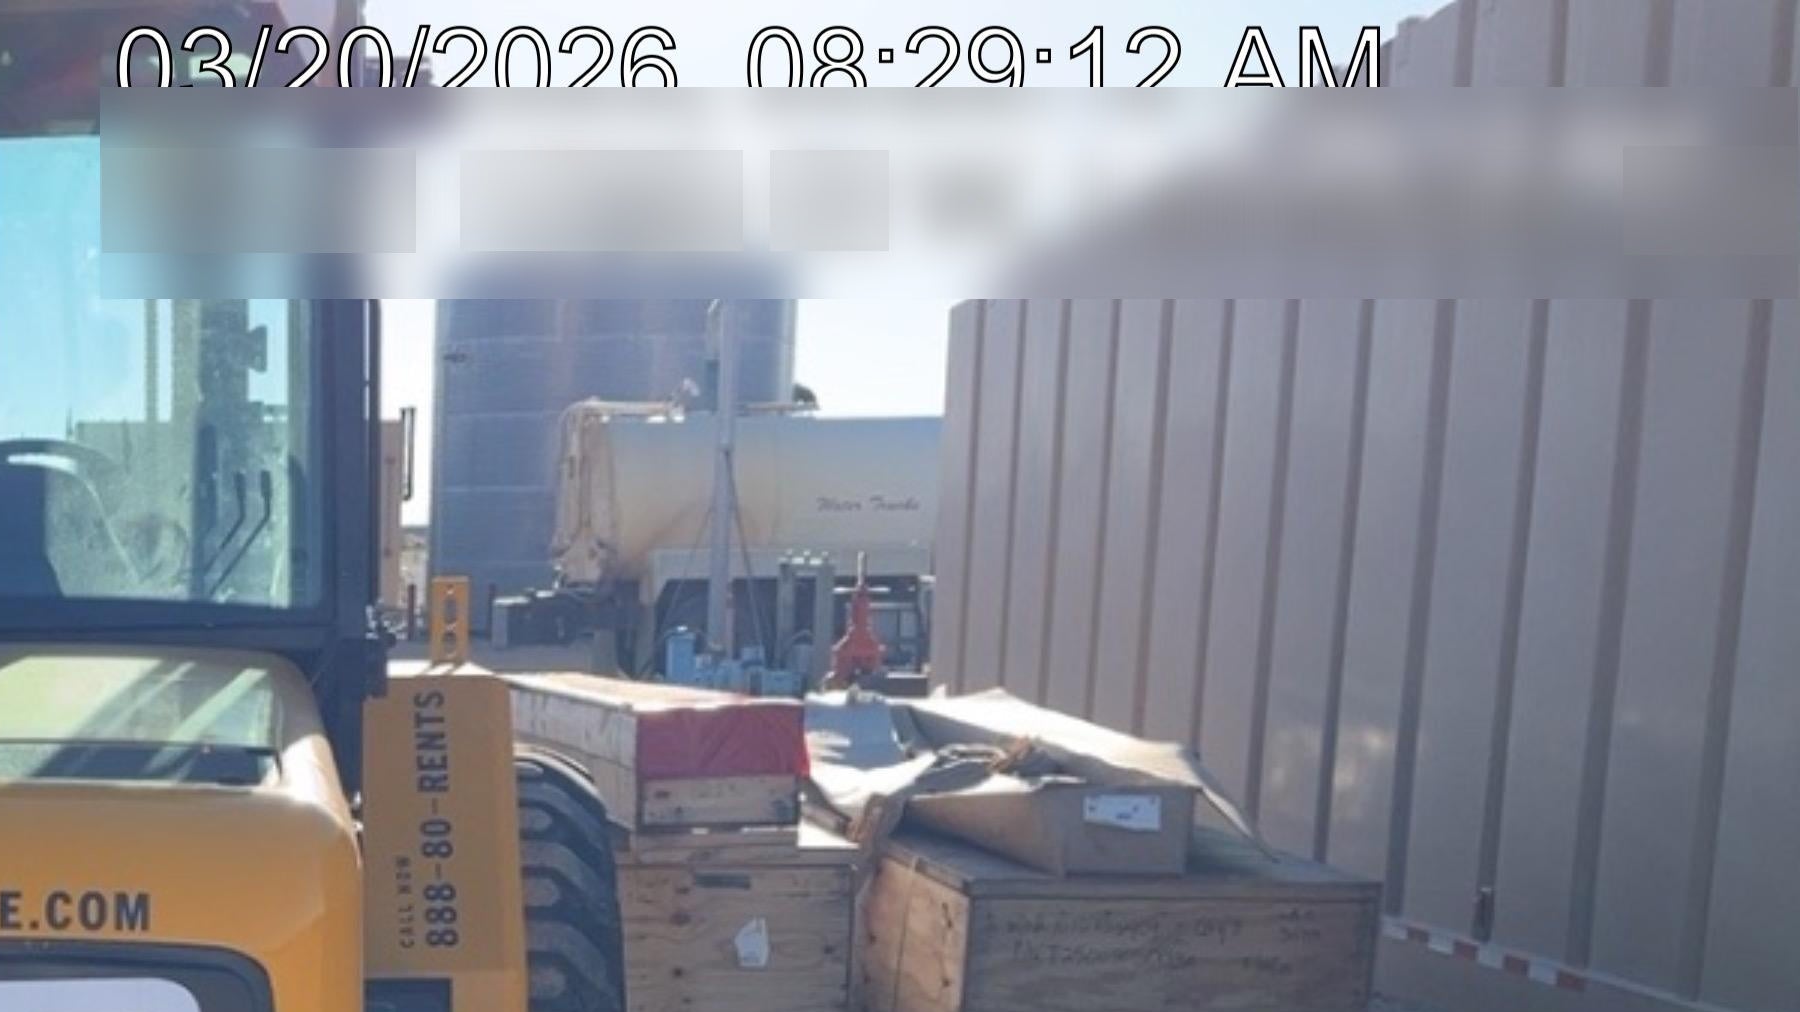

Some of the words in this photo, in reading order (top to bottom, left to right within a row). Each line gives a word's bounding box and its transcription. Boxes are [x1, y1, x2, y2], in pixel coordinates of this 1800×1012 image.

[414, 690, 458, 948] 888-80-RENTS
[395, 856, 411, 895] NOW
[398, 904, 415, 949] CALL
